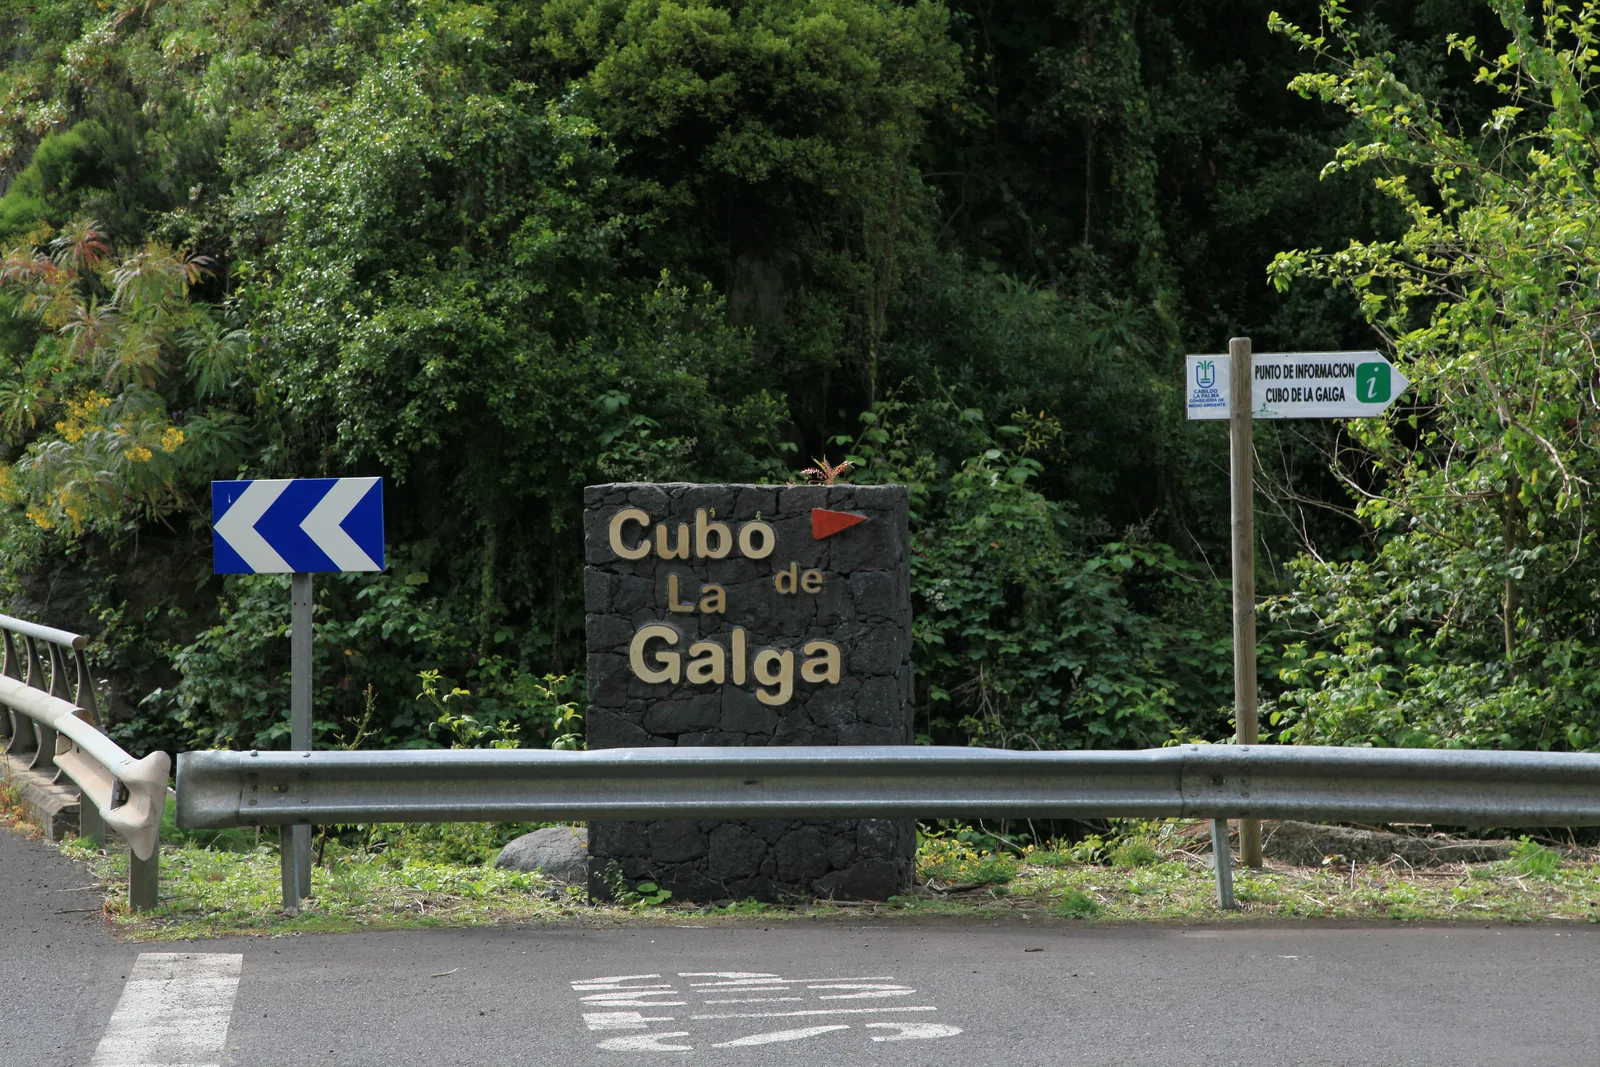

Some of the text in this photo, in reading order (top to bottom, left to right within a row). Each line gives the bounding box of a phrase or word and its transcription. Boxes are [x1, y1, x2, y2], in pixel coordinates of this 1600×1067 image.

[1255, 363, 1355, 380] PUNTO DE INFORMACION
[1266, 387, 1345, 403] CUBO DE LA GALGA
[609, 508, 776, 560] Cubo
[668, 573, 726, 613] La
[774, 562, 824, 594] de
[629, 625, 841, 706] Galga
